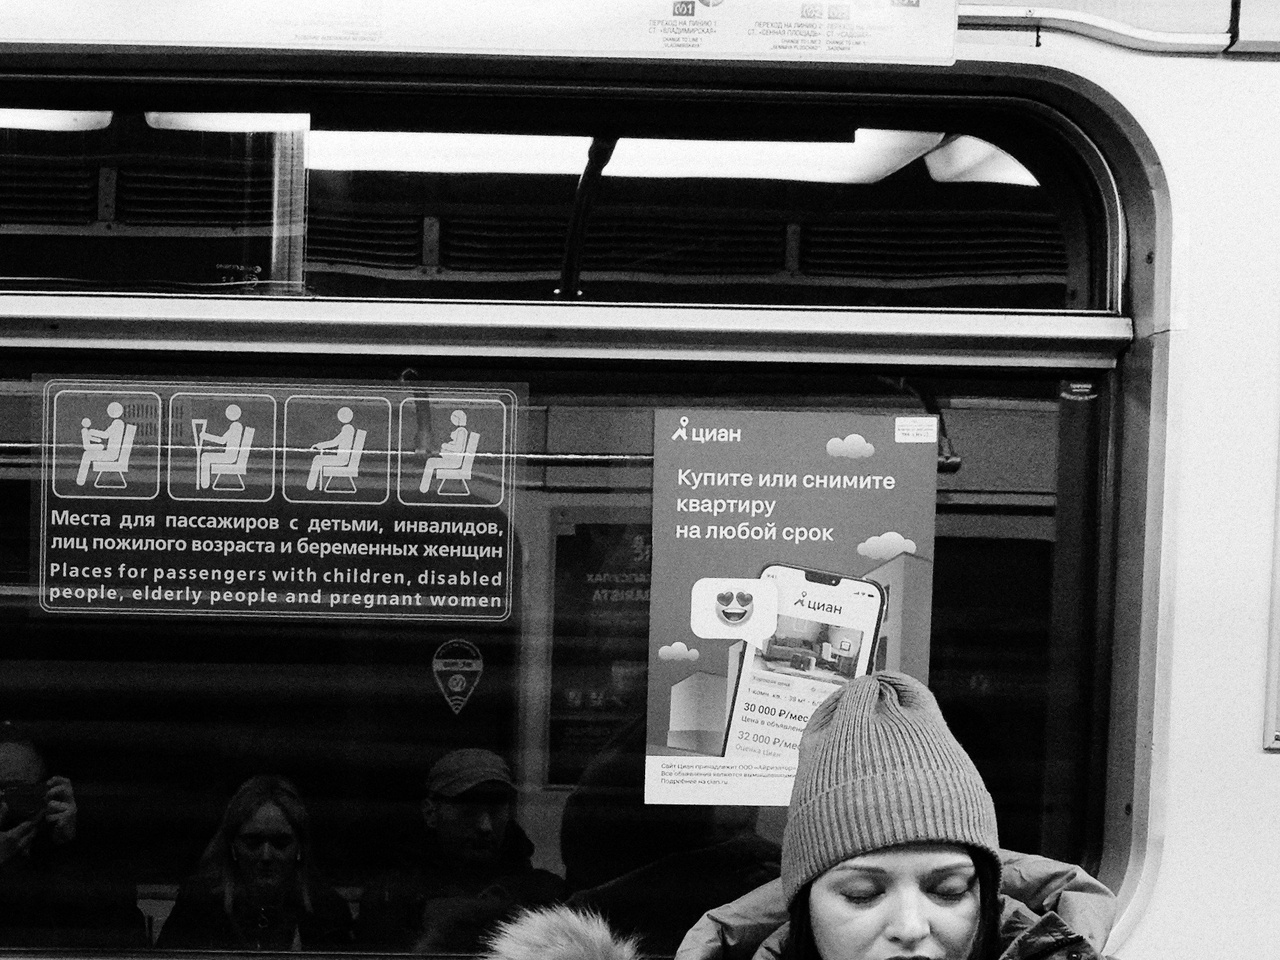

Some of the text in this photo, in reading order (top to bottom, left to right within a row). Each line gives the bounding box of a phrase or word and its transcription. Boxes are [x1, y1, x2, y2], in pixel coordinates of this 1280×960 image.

[692, 428, 741, 443] циан
[677, 469, 896, 490] Купите или снимите
[676, 498, 776, 518] квартиру
[51, 510, 504, 537] Места для пассажиров с детьми, инвалидов,
[675, 523, 834, 544] на любой срок
[50, 537, 503, 560] лиц пожилого возраста и беременных женщин
[50, 564, 503, 588] Places for passengers with children, disabled
[50, 585, 502, 610] people, elderly people and pregnant women
[807, 600, 843, 615] циан
[744, 702, 756, 712] 30
[758, 705, 776, 716] 000
[741, 715, 759, 724] Цена
[738, 731, 750, 741] 32
[752, 734, 770, 745] 000
[735, 743, 761, 754] Оценка
